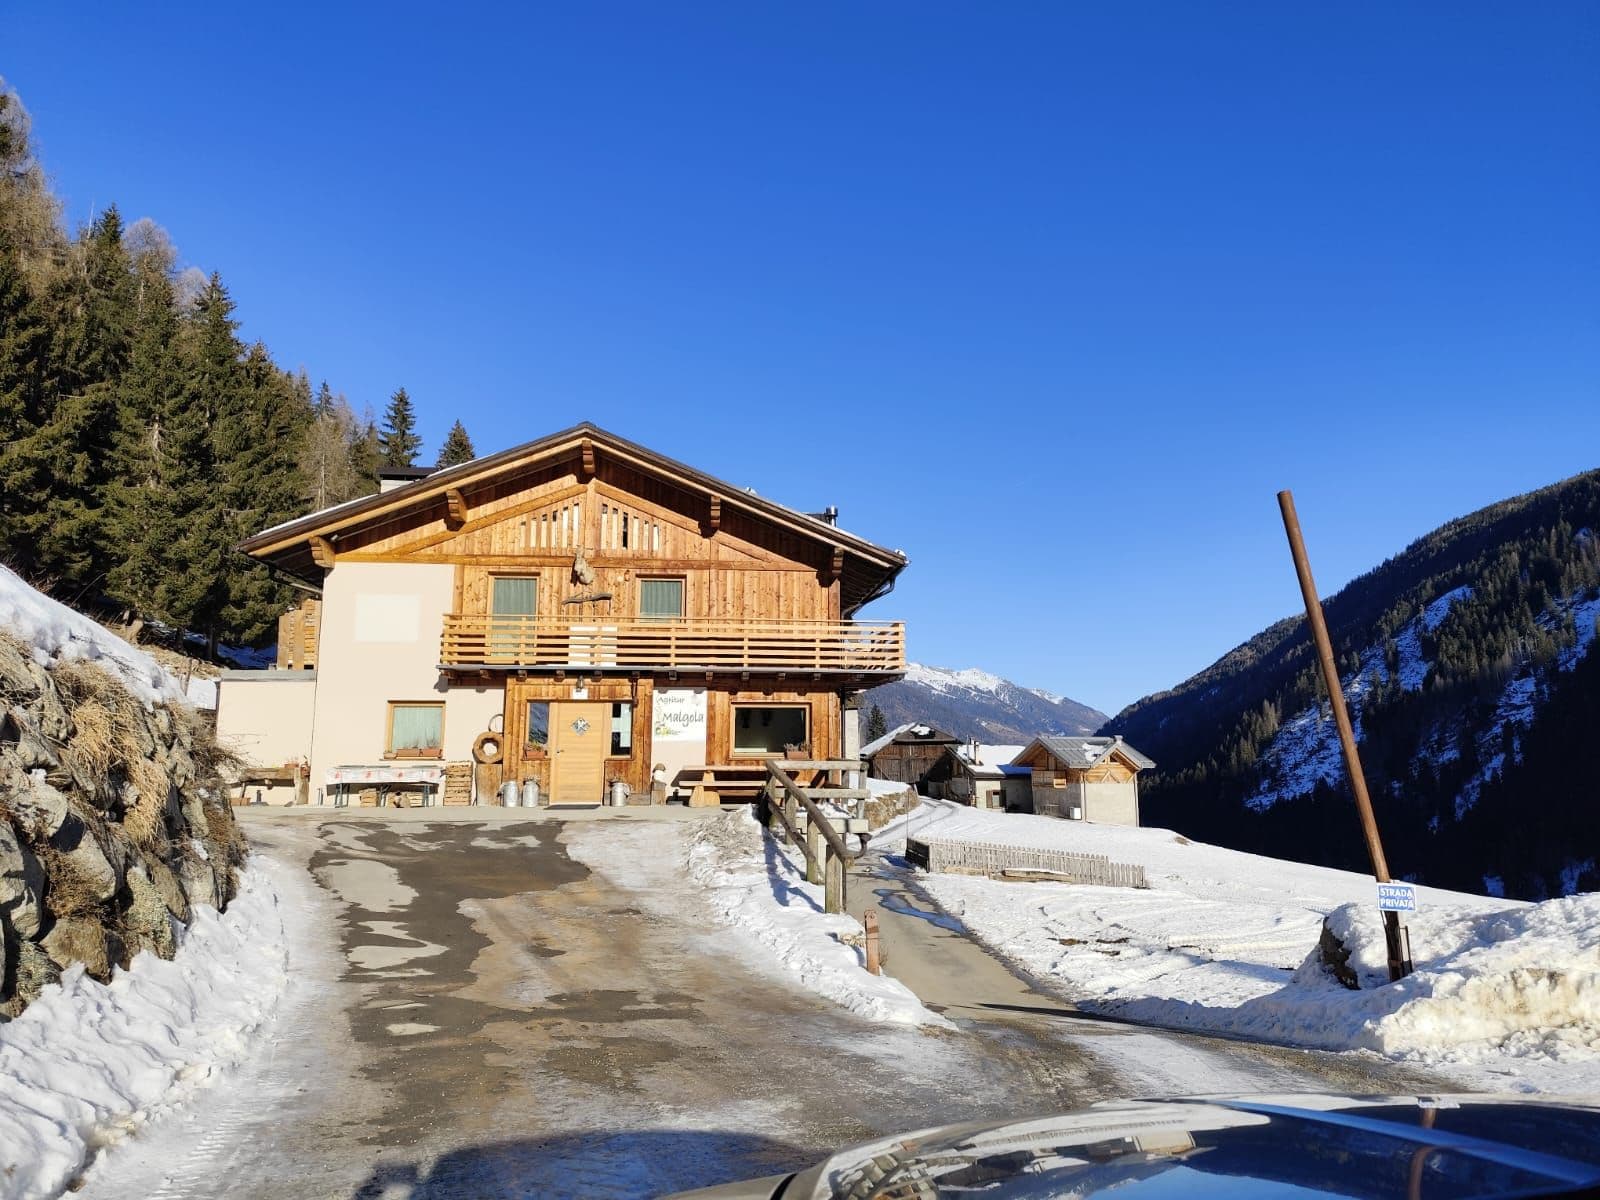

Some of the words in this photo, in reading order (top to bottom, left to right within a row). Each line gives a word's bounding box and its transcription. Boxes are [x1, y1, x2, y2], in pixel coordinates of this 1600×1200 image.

[662, 711, 704, 727] Malgola
[1380, 887, 1413, 898] STRADA
[1380, 898, 1414, 908] PRIVATA
